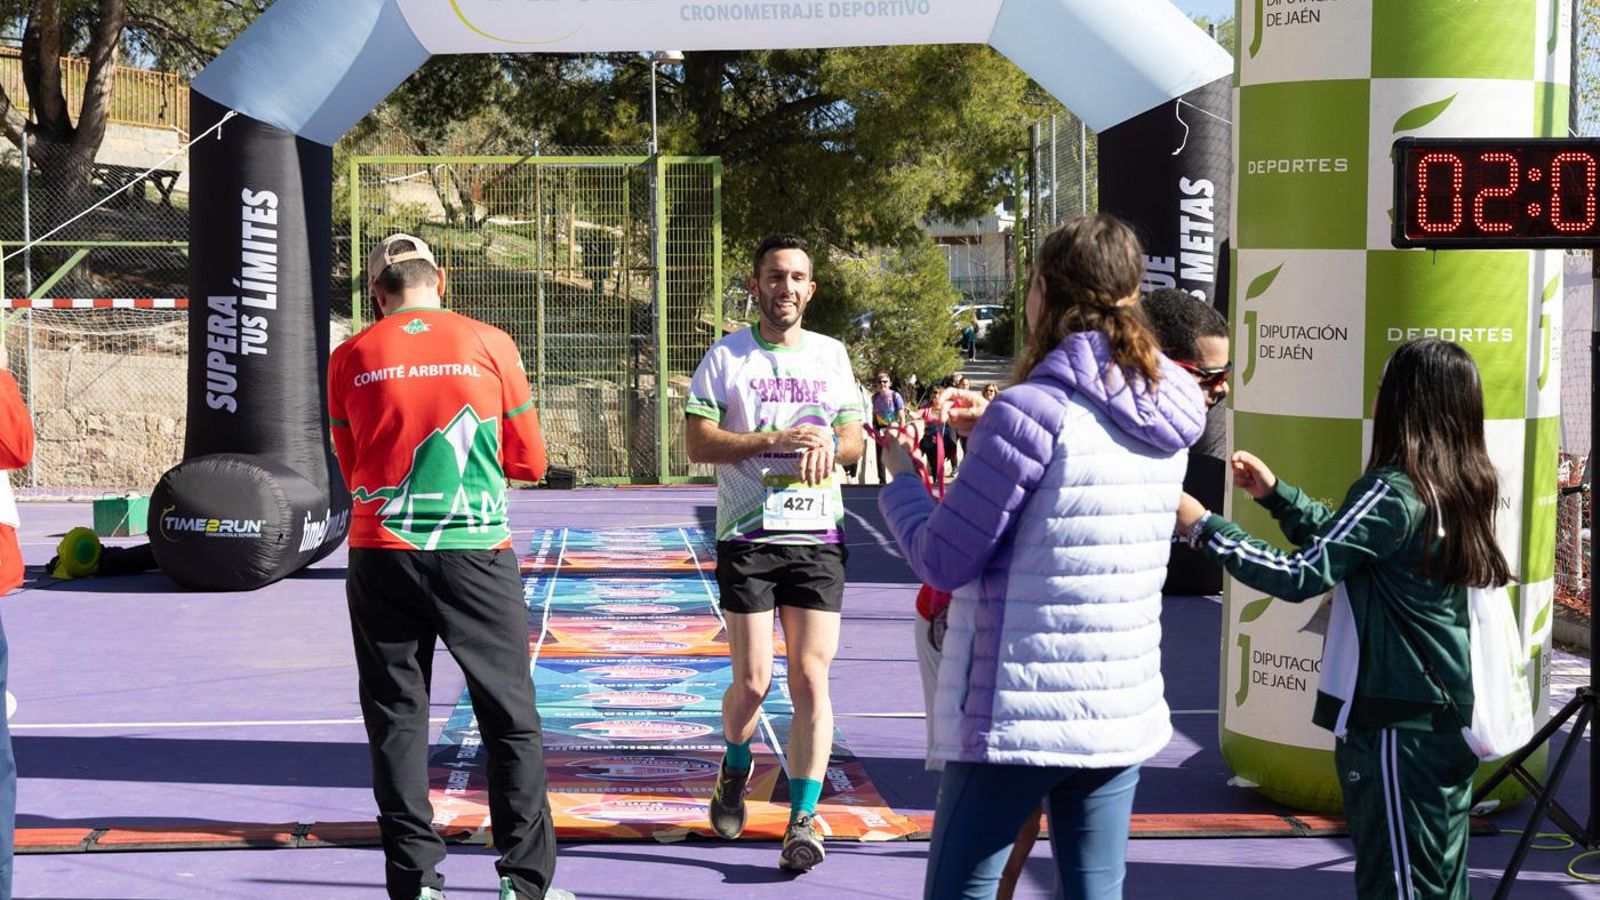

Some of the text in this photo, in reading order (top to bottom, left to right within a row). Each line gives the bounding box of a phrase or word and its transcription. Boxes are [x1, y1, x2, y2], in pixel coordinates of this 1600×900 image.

[679, 0, 930, 22] CRONOMETRAJE DEPORTIVO
[1266, 7, 1321, 27] DE JAÉN
[1247, 158, 1348, 174] DEPORTES
[1179, 176, 1214, 282] METAS
[232, 187, 279, 356] TUS LÍMITES
[1260, 324, 1348, 341] DIPUTACIÓN
[1387, 327, 1513, 343] DEPORTES
[206, 295, 238, 413] SUPERA
[1260, 343, 1313, 360] DE JAÉN
[354, 363, 481, 387] COMITÉ ARBITRAL
[749, 378, 828, 393] CARRERA DE
[761, 388, 786, 403] SAN
[783, 497, 814, 511] 427
[164, 516, 262, 533] TIME2RUN
[1252, 670, 1306, 691] DE JAÉN
